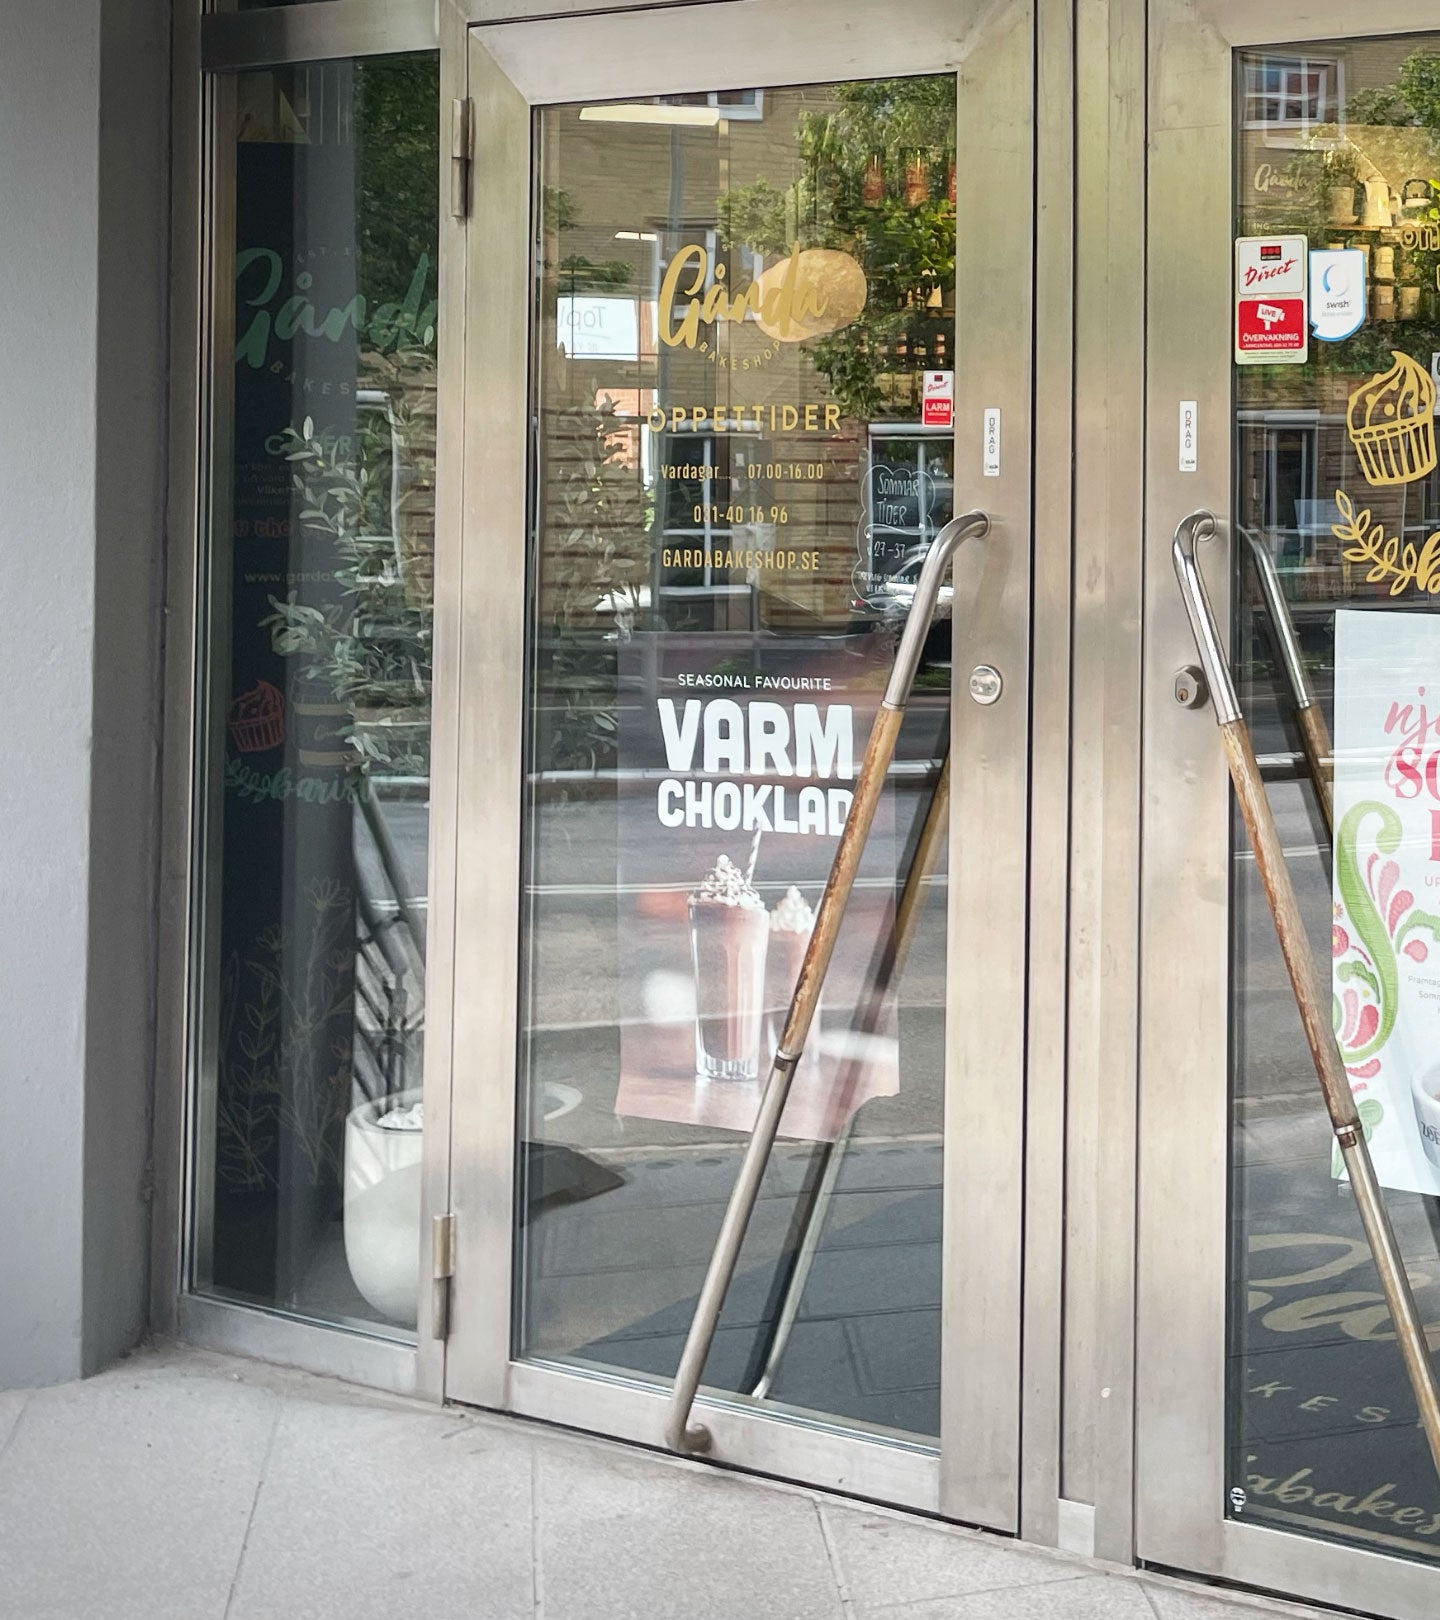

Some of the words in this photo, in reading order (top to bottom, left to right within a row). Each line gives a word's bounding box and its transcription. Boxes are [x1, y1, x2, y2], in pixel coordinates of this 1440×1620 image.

[1244, 258, 1298, 286] Direct
[658, 241, 830, 349] Gårda
[1326, 300, 1350, 309] swish
[1261, 307, 1277, 318] LIVE
[1243, 332, 1299, 342] ÖVERVAKNING
[700, 340, 781, 371] BAKESHOP
[925, 402, 950, 412] LARM
[988, 417, 996, 454] DRAG
[750, 506, 764, 523] 16
[771, 506, 788, 524] 96
[662, 549, 820, 571] GARDABAKESHOP.SE
[678, 673, 750, 688] SEASONAL
[755, 676, 831, 691] FAVOURITE
[657, 698, 853, 780] VARM
[658, 778, 854, 836] CHOKLAD
